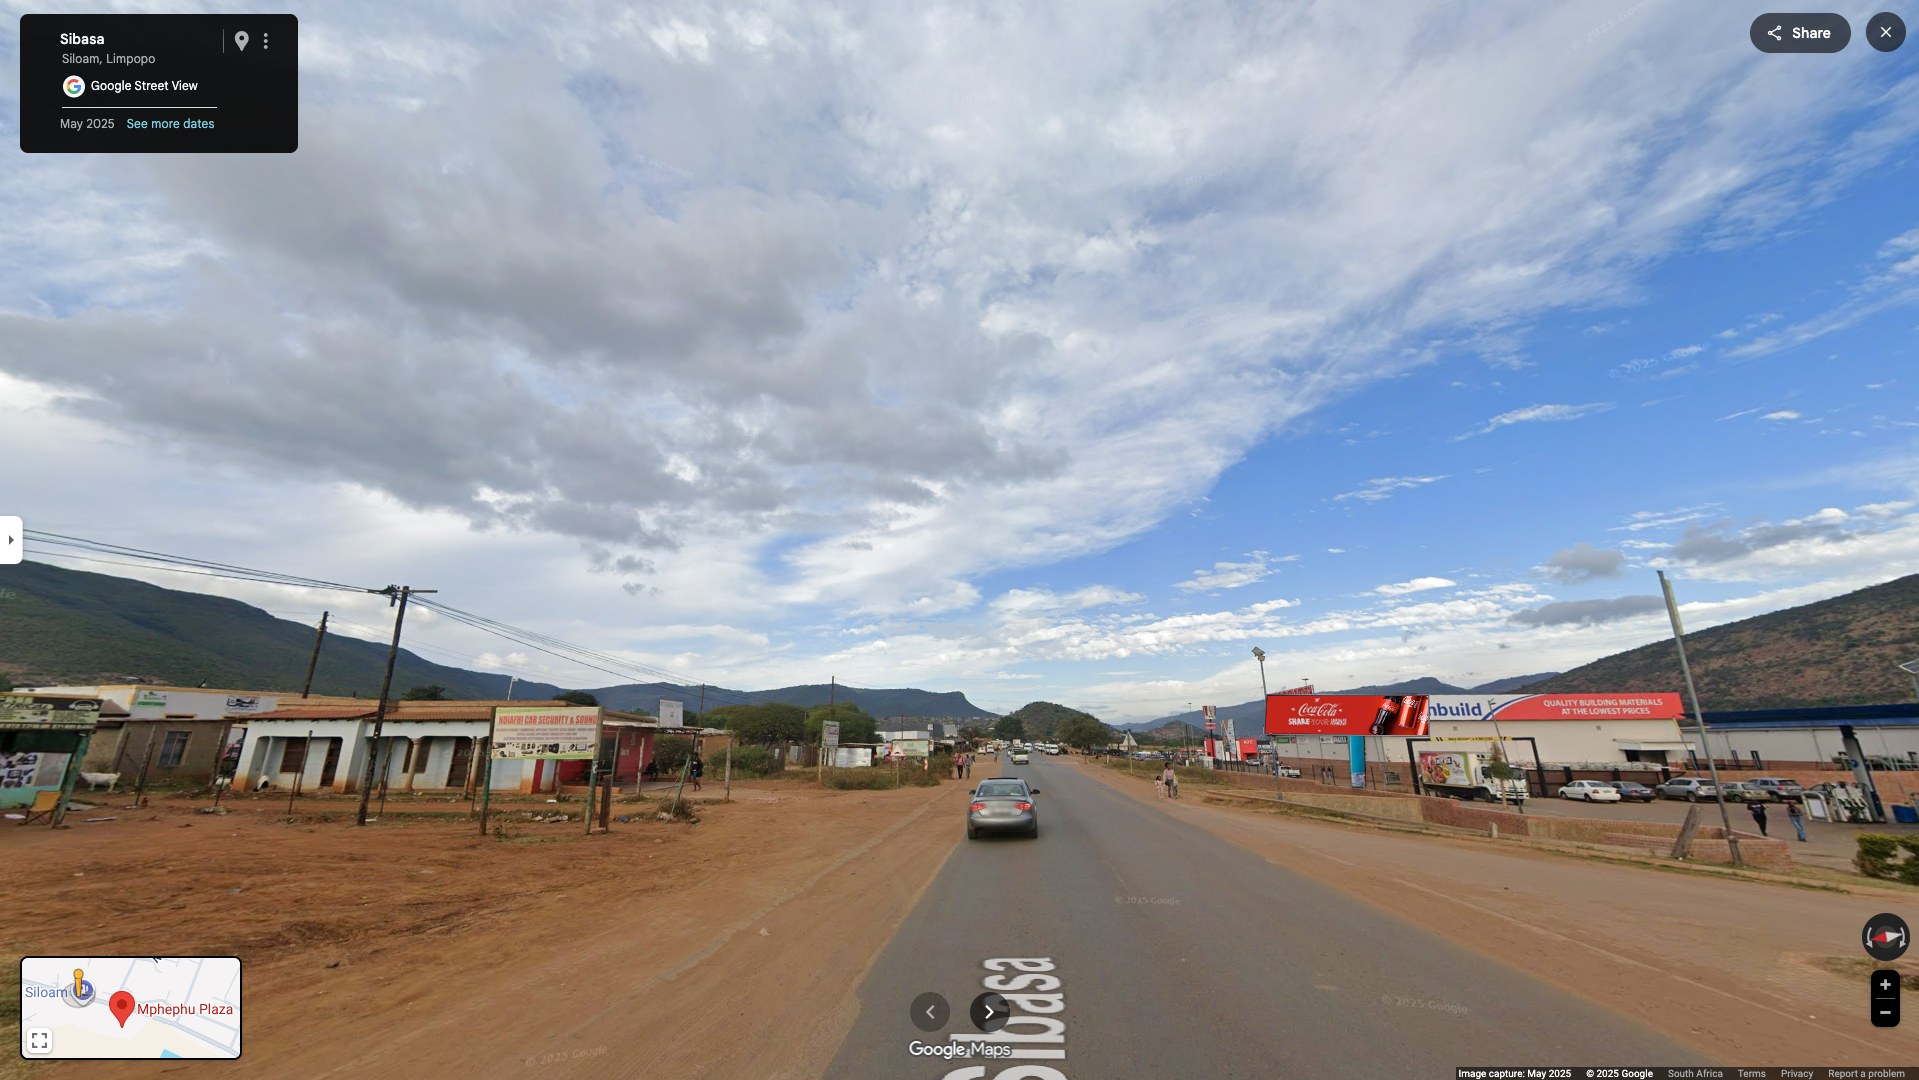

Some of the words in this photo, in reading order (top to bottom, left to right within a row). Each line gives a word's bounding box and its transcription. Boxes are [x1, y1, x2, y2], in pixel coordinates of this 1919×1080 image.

[1543, 699, 1578, 707] QUALITY
[1619, 698, 1664, 706] MATERIALS
[1623, 707, 1650, 715] PRICES
[525, 715, 538, 725] CAR
[538, 715, 568, 725] SECURITY
